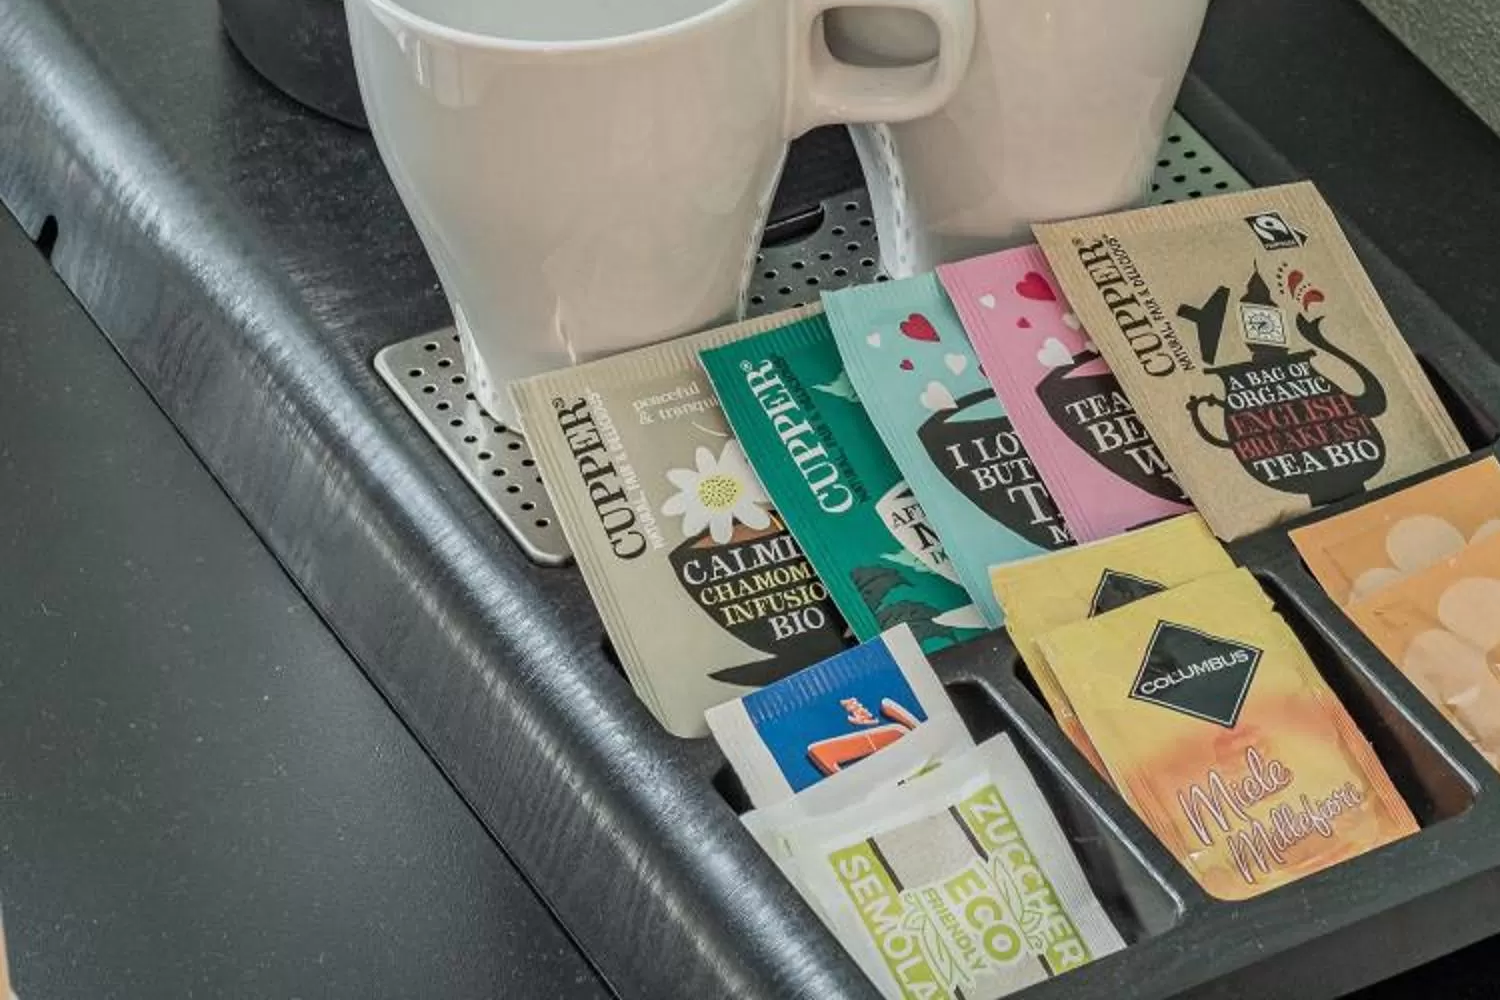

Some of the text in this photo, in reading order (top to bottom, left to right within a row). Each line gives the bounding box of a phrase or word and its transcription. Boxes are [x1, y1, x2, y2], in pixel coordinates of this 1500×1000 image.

[1227, 376, 1331, 410] ORGANIC
[1229, 361, 1312, 391] A BAG OF
[1065, 391, 1133, 424] TEA
[1229, 394, 1357, 437] ENGLISH
[946, 431, 1020, 469] I LO
[1234, 417, 1371, 460] BREAKFAST
[971, 457, 1034, 490] BUT
[1253, 439, 1380, 482] TEA BIO
[1007, 482, 1056, 525] T
[700, 561, 815, 605] CHAMOM
[720, 582, 827, 627] INFUSIO
[768, 606, 825, 641] BIO
[1140, 650, 1249, 695] COLUMBUS
[1178, 746, 1293, 845] Miele
[1226, 781, 1362, 884] Millefiori
[922, 888, 987, 970] FRIENDLY
[944, 868, 1021, 962] ECO
